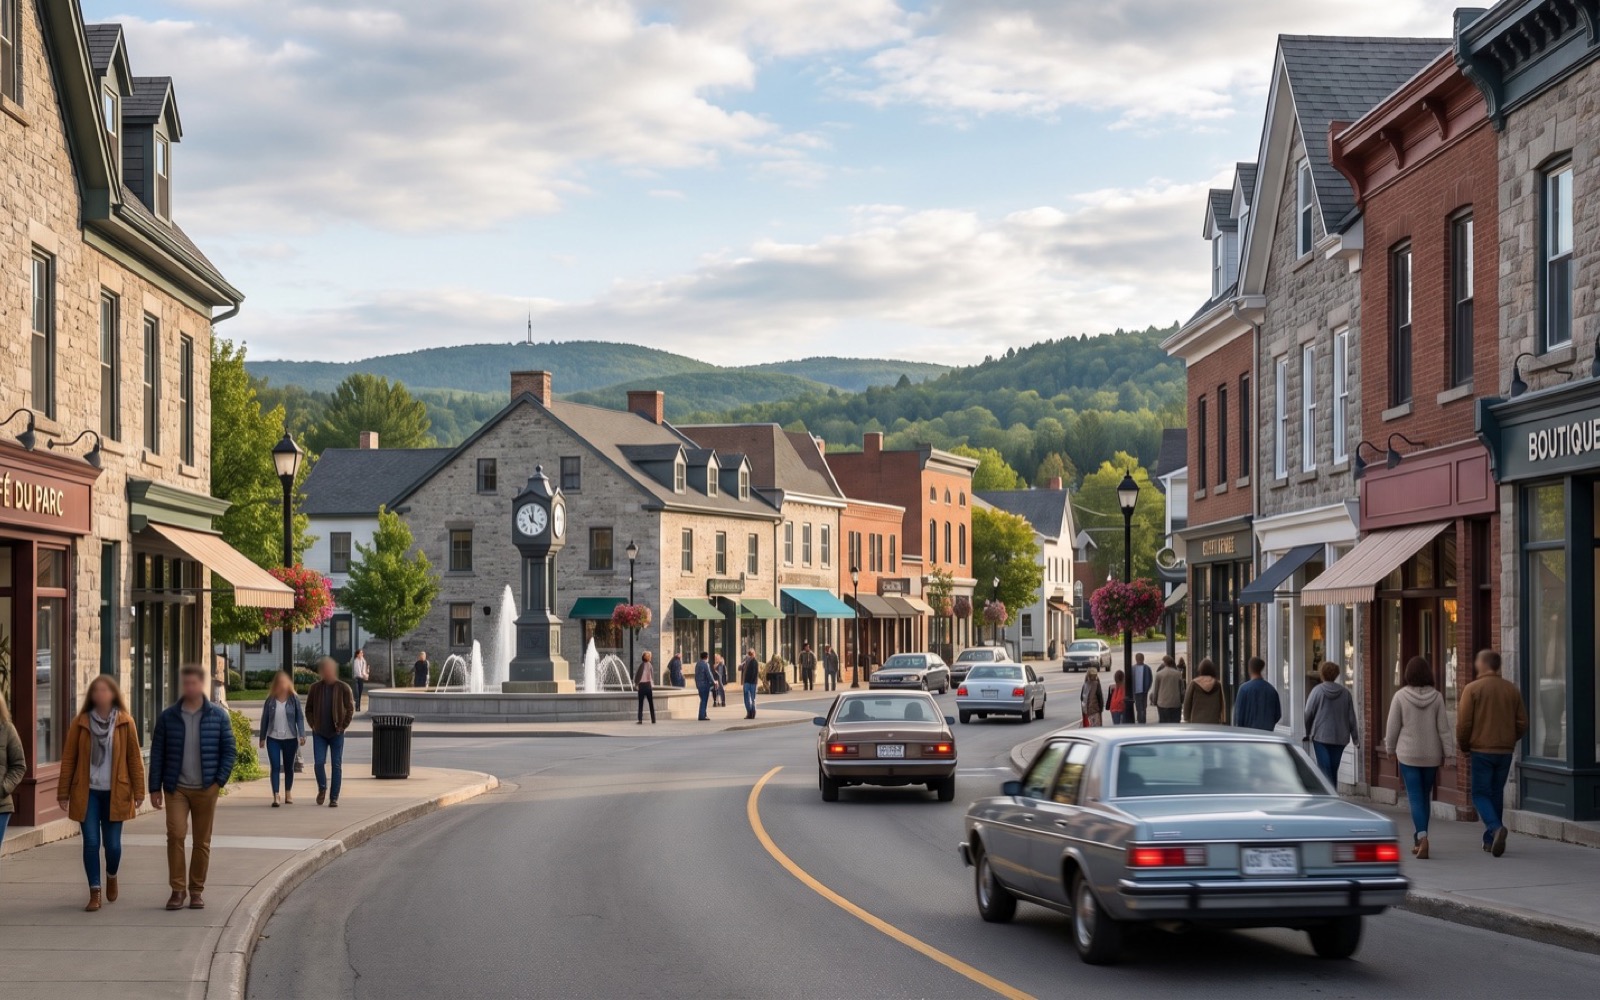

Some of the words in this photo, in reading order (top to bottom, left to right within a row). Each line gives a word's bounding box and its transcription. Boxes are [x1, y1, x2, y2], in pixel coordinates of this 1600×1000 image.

[1528, 419, 1600, 462] BOUTIQUE
[14, 480, 32, 511] DU
[34, 484, 64, 517] PARC
